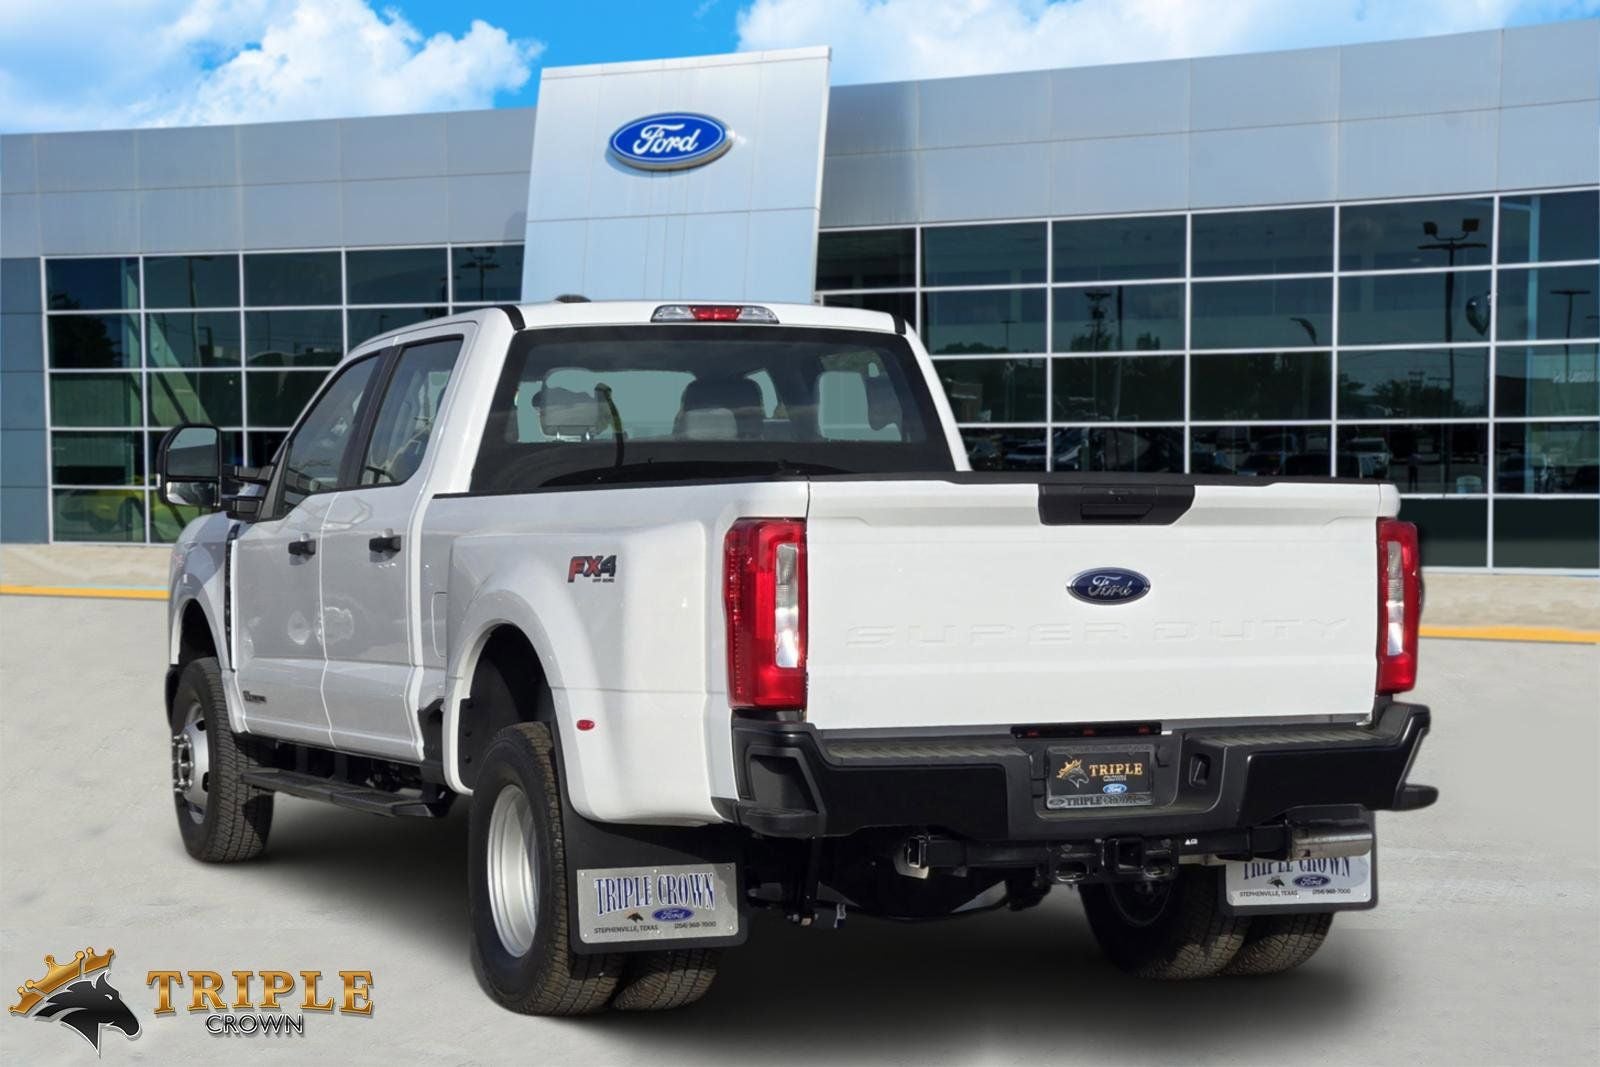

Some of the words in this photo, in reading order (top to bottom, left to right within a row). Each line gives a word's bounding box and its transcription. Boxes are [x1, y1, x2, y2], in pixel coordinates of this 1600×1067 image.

[632, 123, 701, 155] Ford
[568, 555, 616, 583] FX4
[1088, 575, 1133, 596] Ford
[846, 623, 1129, 648] SUPER
[1152, 617, 1350, 641] DUTY
[1089, 763, 1143, 776] TRIPLE
[596, 877, 652, 915] TRIPLE
[658, 873, 714, 909] CROWN
[660, 910, 685, 920] Ford
